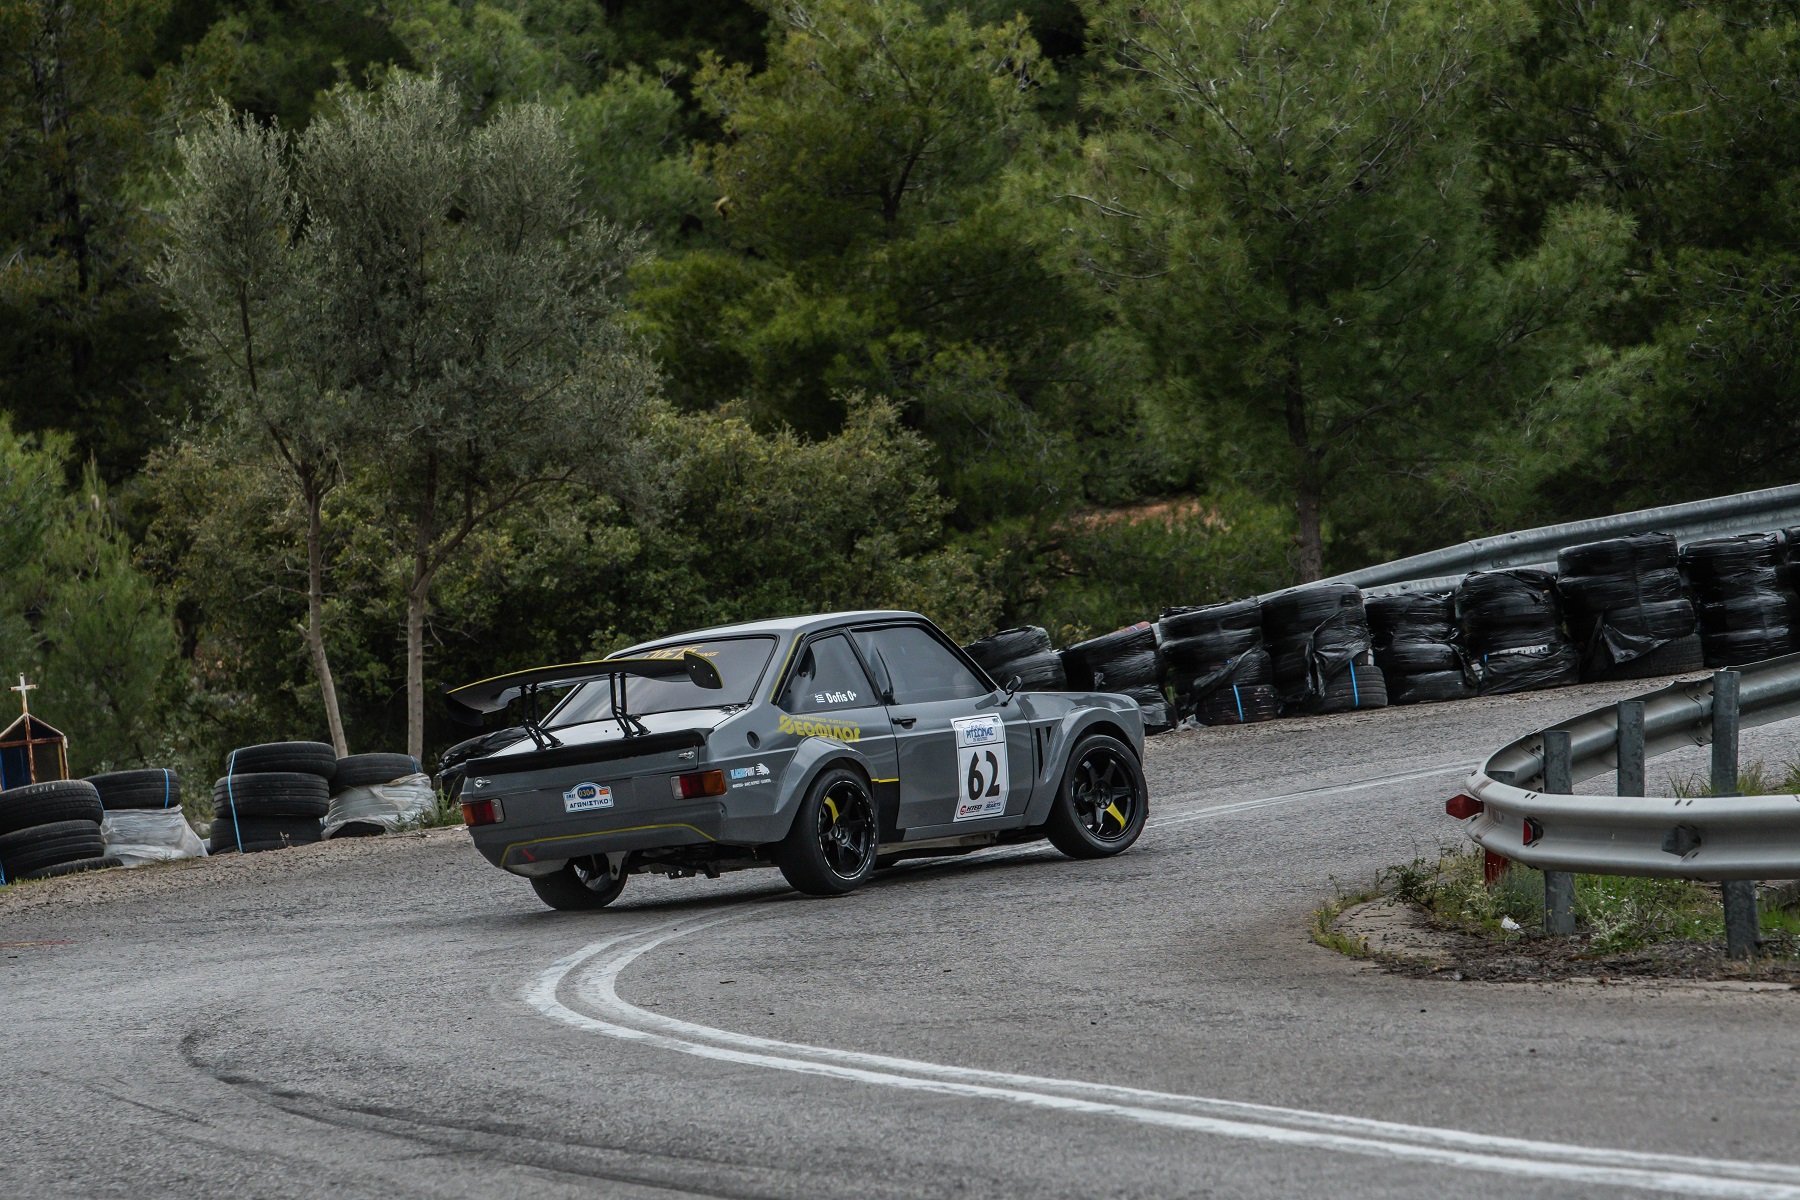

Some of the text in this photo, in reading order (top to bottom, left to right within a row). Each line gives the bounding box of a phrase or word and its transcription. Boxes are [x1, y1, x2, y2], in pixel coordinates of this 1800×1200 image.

[825, 691, 847, 704] Dofis
[967, 750, 1000, 800] 62
[578, 788, 595, 797] 0304
[569, 798, 609, 809] ΑΓΩΝΙΣΤΙΚΟ
